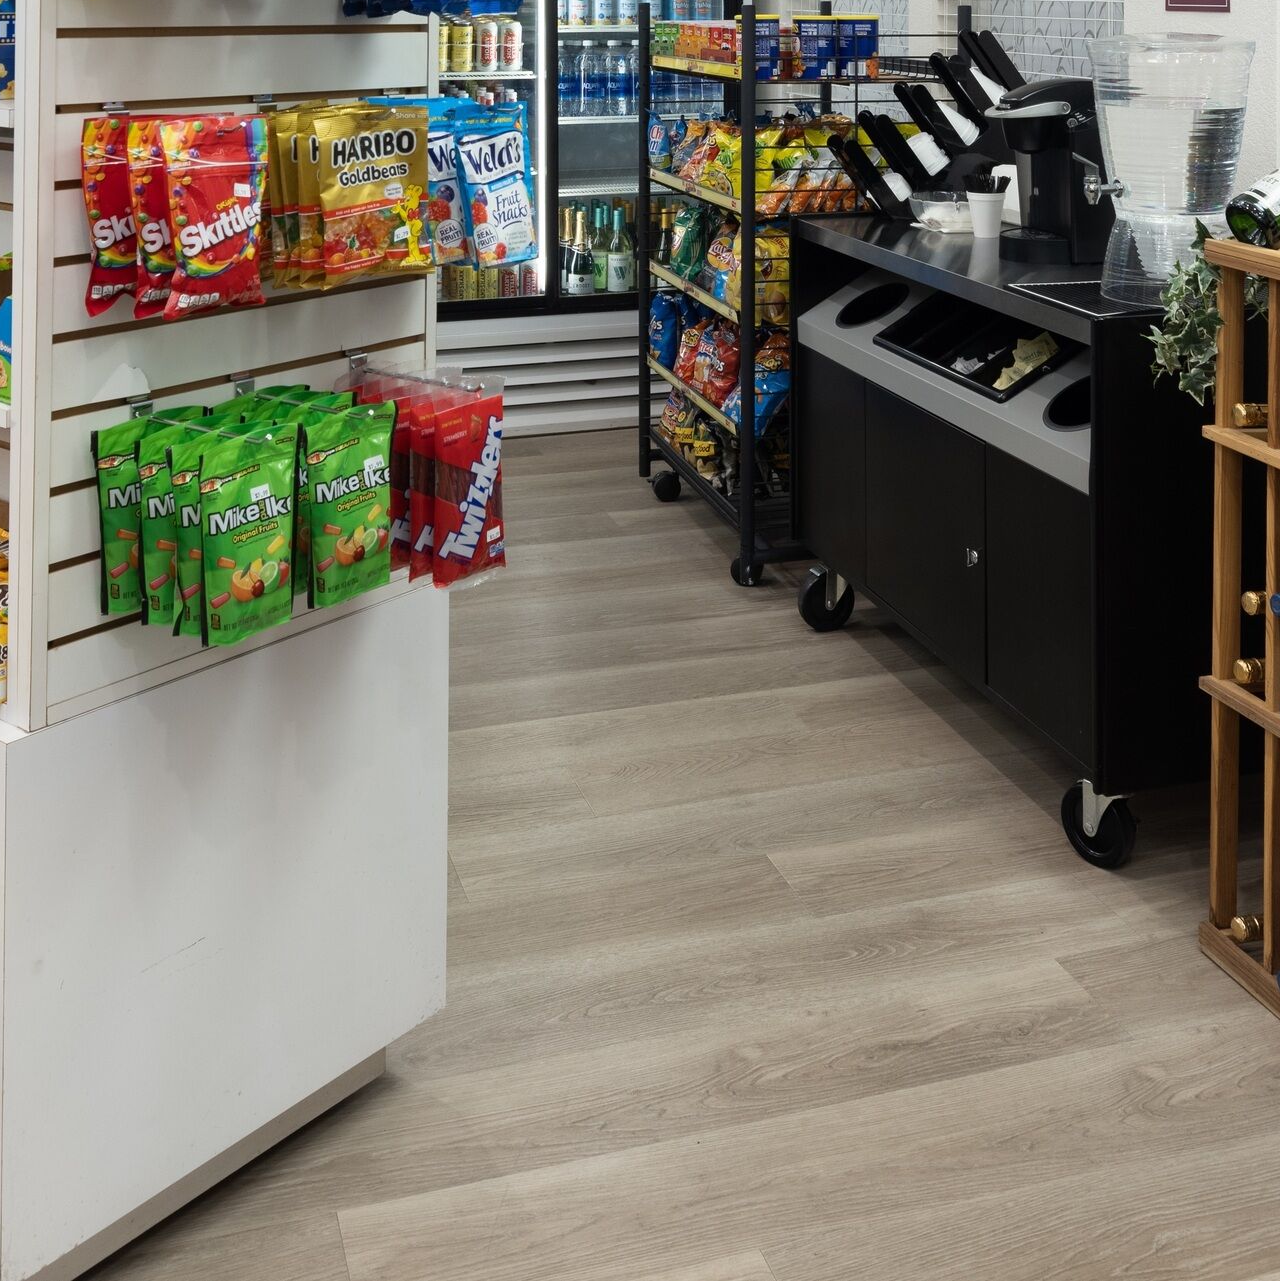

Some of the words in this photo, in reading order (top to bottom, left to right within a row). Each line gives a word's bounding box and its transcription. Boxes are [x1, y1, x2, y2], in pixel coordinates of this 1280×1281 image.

[333, 130, 415, 166] HARIBO
[460, 136, 522, 177] Welch's
[339, 163, 408, 187] Goldbears
[495, 190, 521, 212] Fruit
[179, 202, 263, 257] Skittles
[439, 226, 457, 238] REAL
[476, 229, 494, 240] REAL
[316, 475, 359, 504] Mike
[364, 466, 391, 488] Ike
[438, 415, 503, 560] Twizzlers
[209, 502, 260, 536] Mike
[266, 495, 292, 518] Ike
[336, 496, 359, 512] Original
[359, 491, 376, 504] Fruits
[232, 527, 259, 544] Original
[258, 521, 279, 535] Fruits
